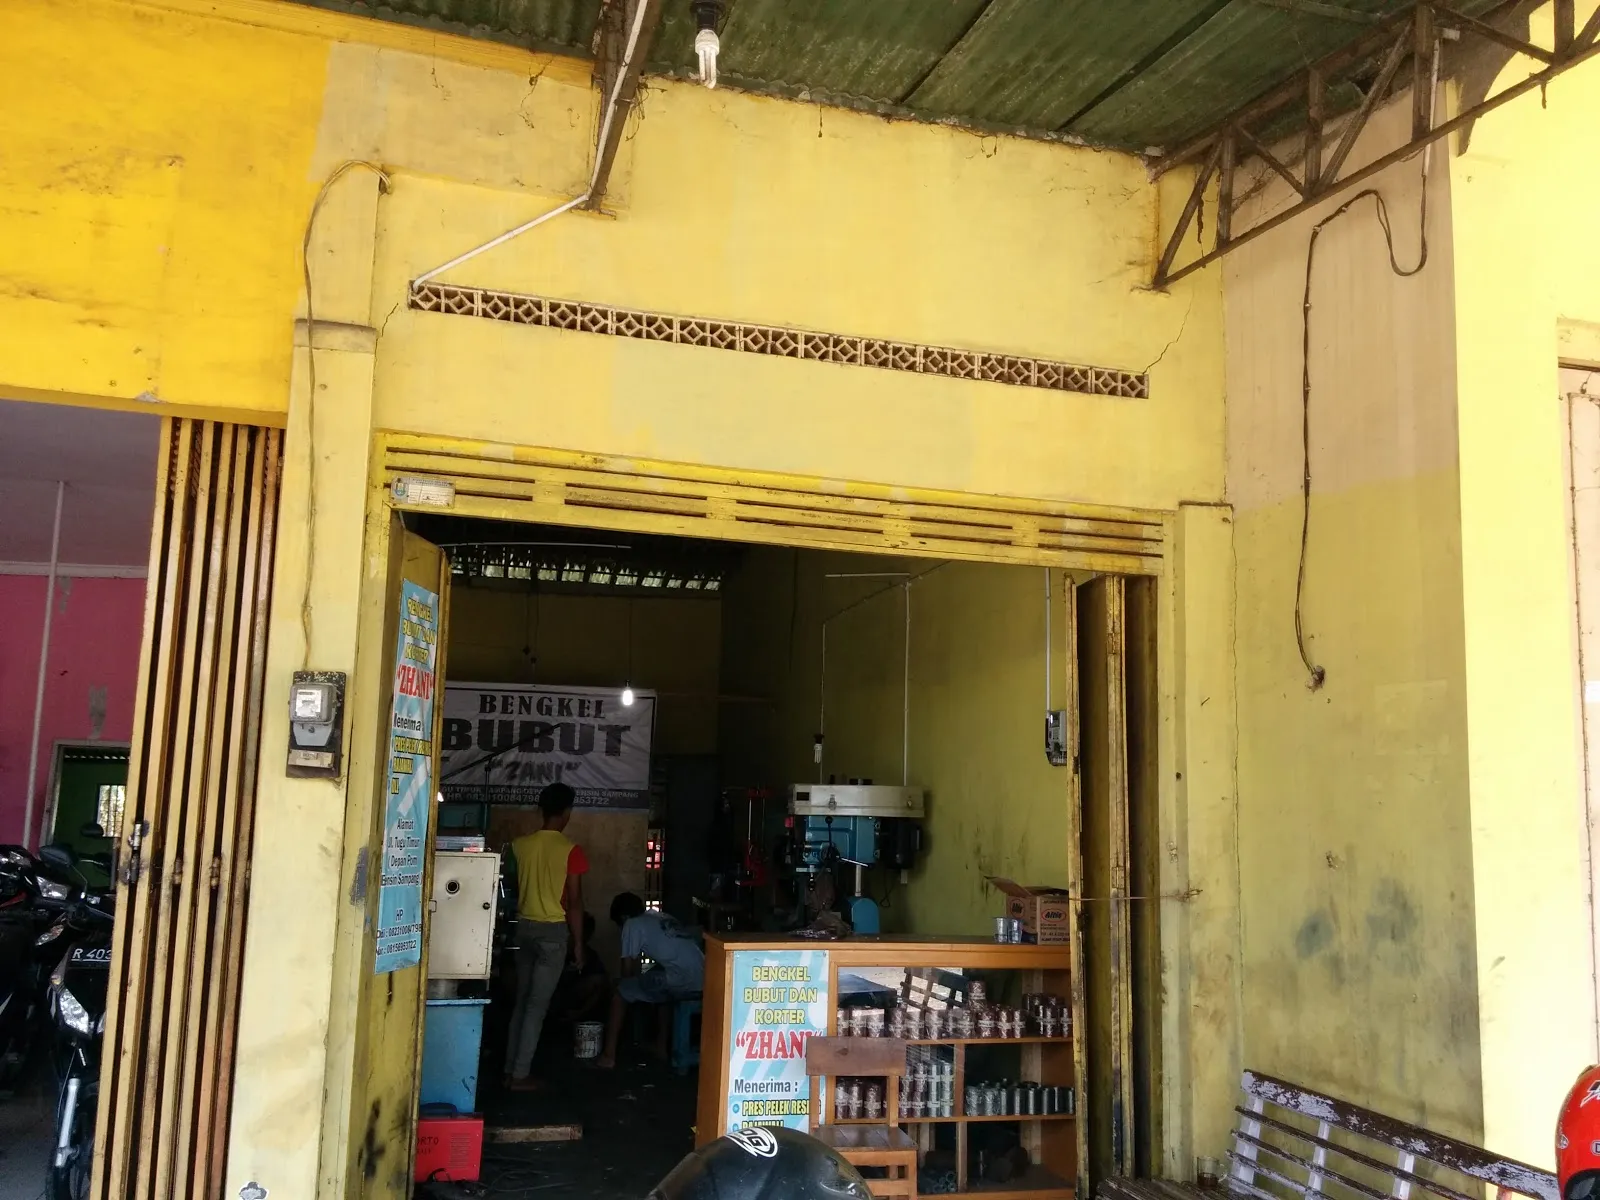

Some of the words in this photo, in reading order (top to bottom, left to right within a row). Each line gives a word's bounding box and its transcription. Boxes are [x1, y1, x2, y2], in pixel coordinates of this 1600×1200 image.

[478, 694, 606, 719] BENGKEL
[442, 717, 631, 757] BUBUT
[601, 791, 639, 799] SAMPANG
[72, 948, 84, 959] R
[752, 965, 811, 982] BENGKEL
[743, 988, 787, 1004] BUBUT
[790, 988, 818, 1004] DAN
[754, 1008, 806, 1025] KORTER
[734, 1078, 792, 1093] Menerima
[742, 1100, 764, 1116] PRES
[765, 1100, 790, 1116] PELEK
